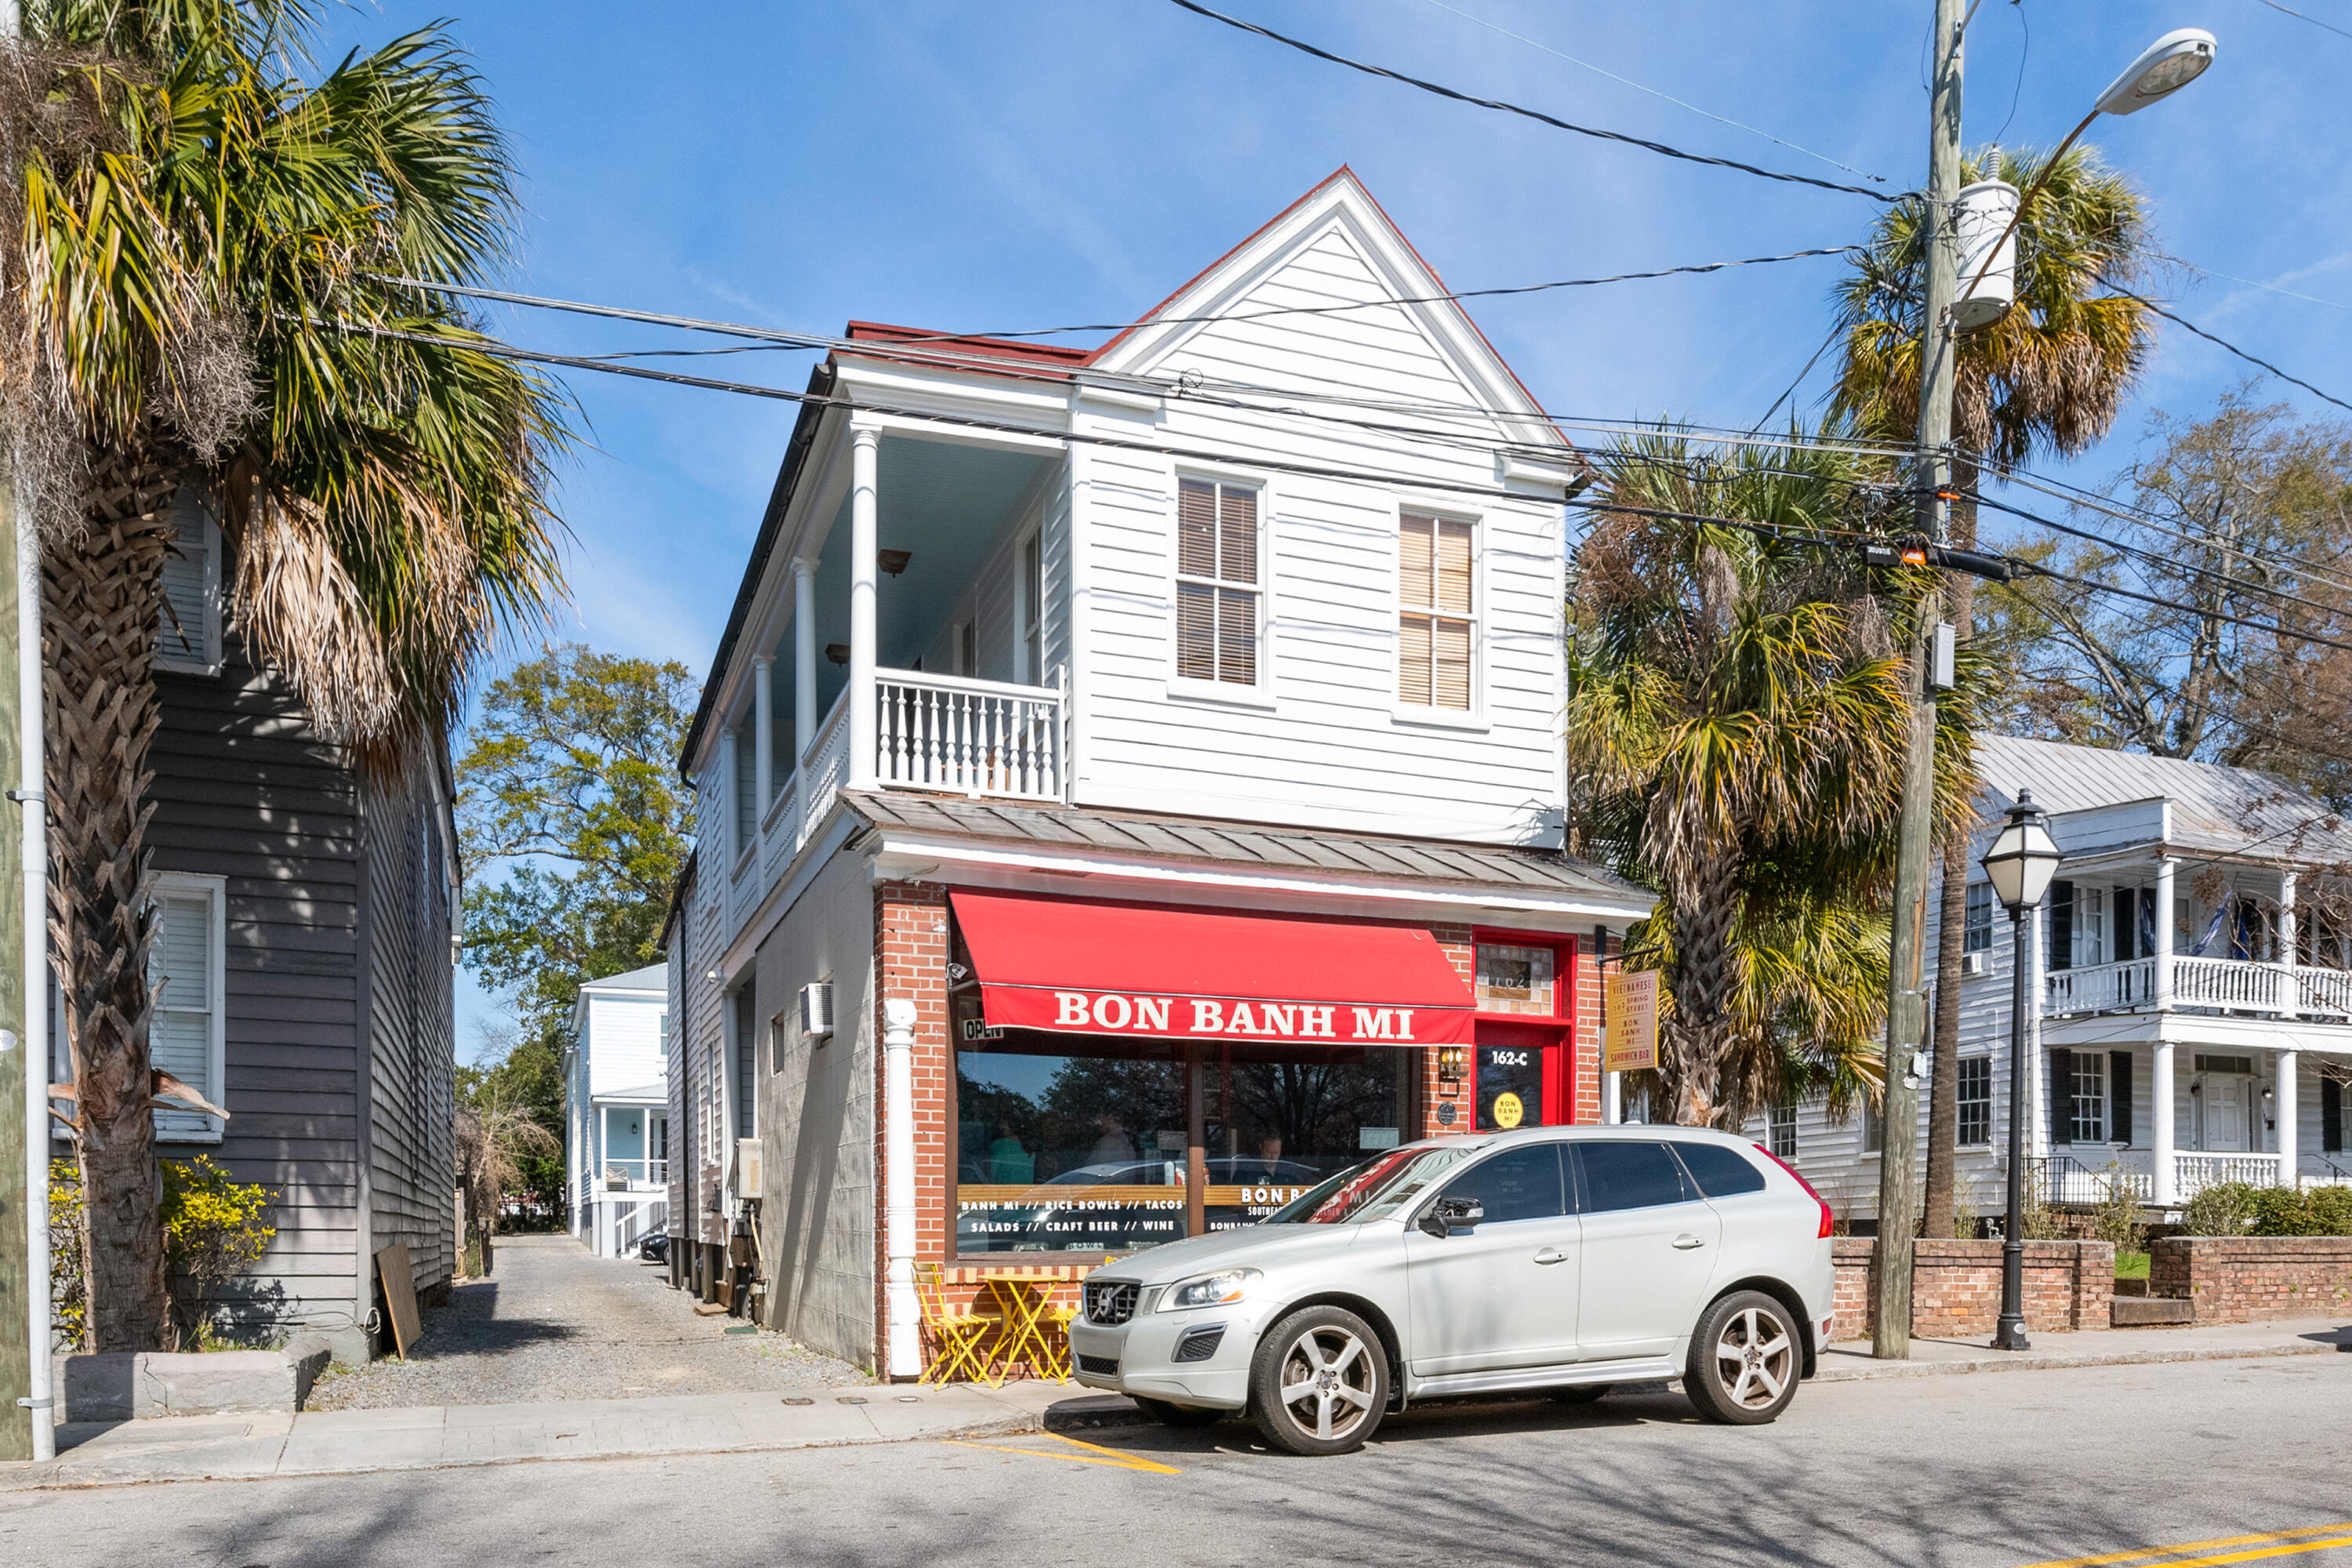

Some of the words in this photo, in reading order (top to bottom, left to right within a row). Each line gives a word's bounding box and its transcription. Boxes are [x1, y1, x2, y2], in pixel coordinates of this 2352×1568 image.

[1613, 979, 1651, 995] VIETNAMESE
[1627, 995, 1649, 1004] SPRING
[1626, 1004, 1648, 1013] STREET
[1054, 992, 1173, 1031] BON
[1189, 1000, 1336, 1037] BANH
[1352, 1007, 1414, 1040] MI
[1621, 1028, 1640, 1036] BANH
[1610, 1051, 1638, 1062] SANDWICH
[1639, 1050, 1650, 1060] BAR
[1241, 1188, 1283, 1203] BON
[961, 1201, 997, 1211] BANH
[1004, 1201, 1018, 1210] MI
[1045, 1200, 1073, 1210] RICE
[1079, 1200, 1120, 1210] BOWLS
[1145, 1200, 1183, 1210] TACOS
[971, 1222, 1020, 1232] SALADS
[1046, 1221, 1083, 1232] CRAFT
[1089, 1221, 1118, 1232] BEER
[1143, 1221, 1174, 1231] WINE
